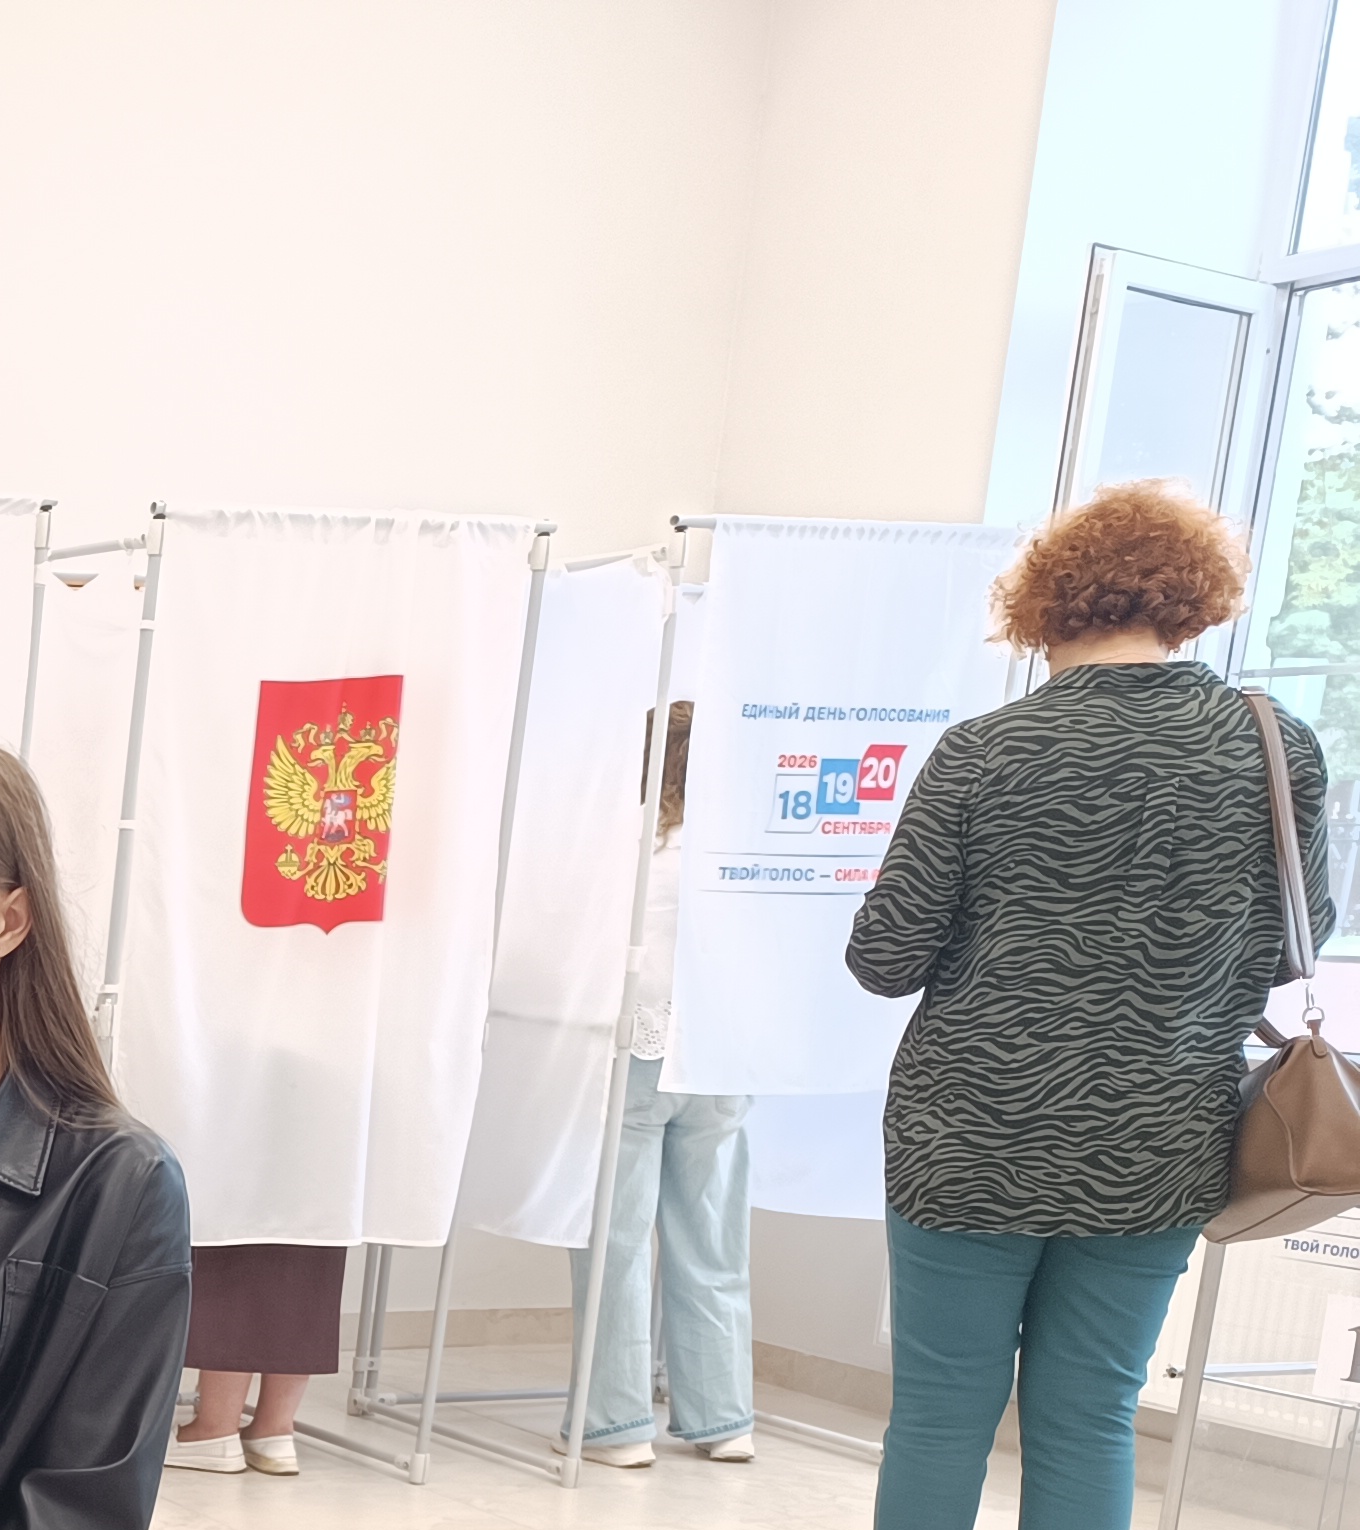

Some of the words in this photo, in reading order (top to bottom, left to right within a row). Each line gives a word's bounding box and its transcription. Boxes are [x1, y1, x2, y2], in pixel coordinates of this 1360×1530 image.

[741, 703, 800, 720] ЕДИНЫЙ
[803, 706, 847, 722] ДЕНЬ
[849, 708, 950, 723] ГОЛОСОВАНИЯ
[777, 755, 818, 769] 2026
[860, 757, 896, 789] 20
[822, 772, 856, 804] 19
[779, 790, 812, 820] 18
[821, 822, 891, 835] СЕНТЯБРЯ
[718, 864, 760, 881] ТВОЙ
[761, 867, 815, 882] ГОЛОС
[1283, 1238, 1320, 1254] ТВОЙ
